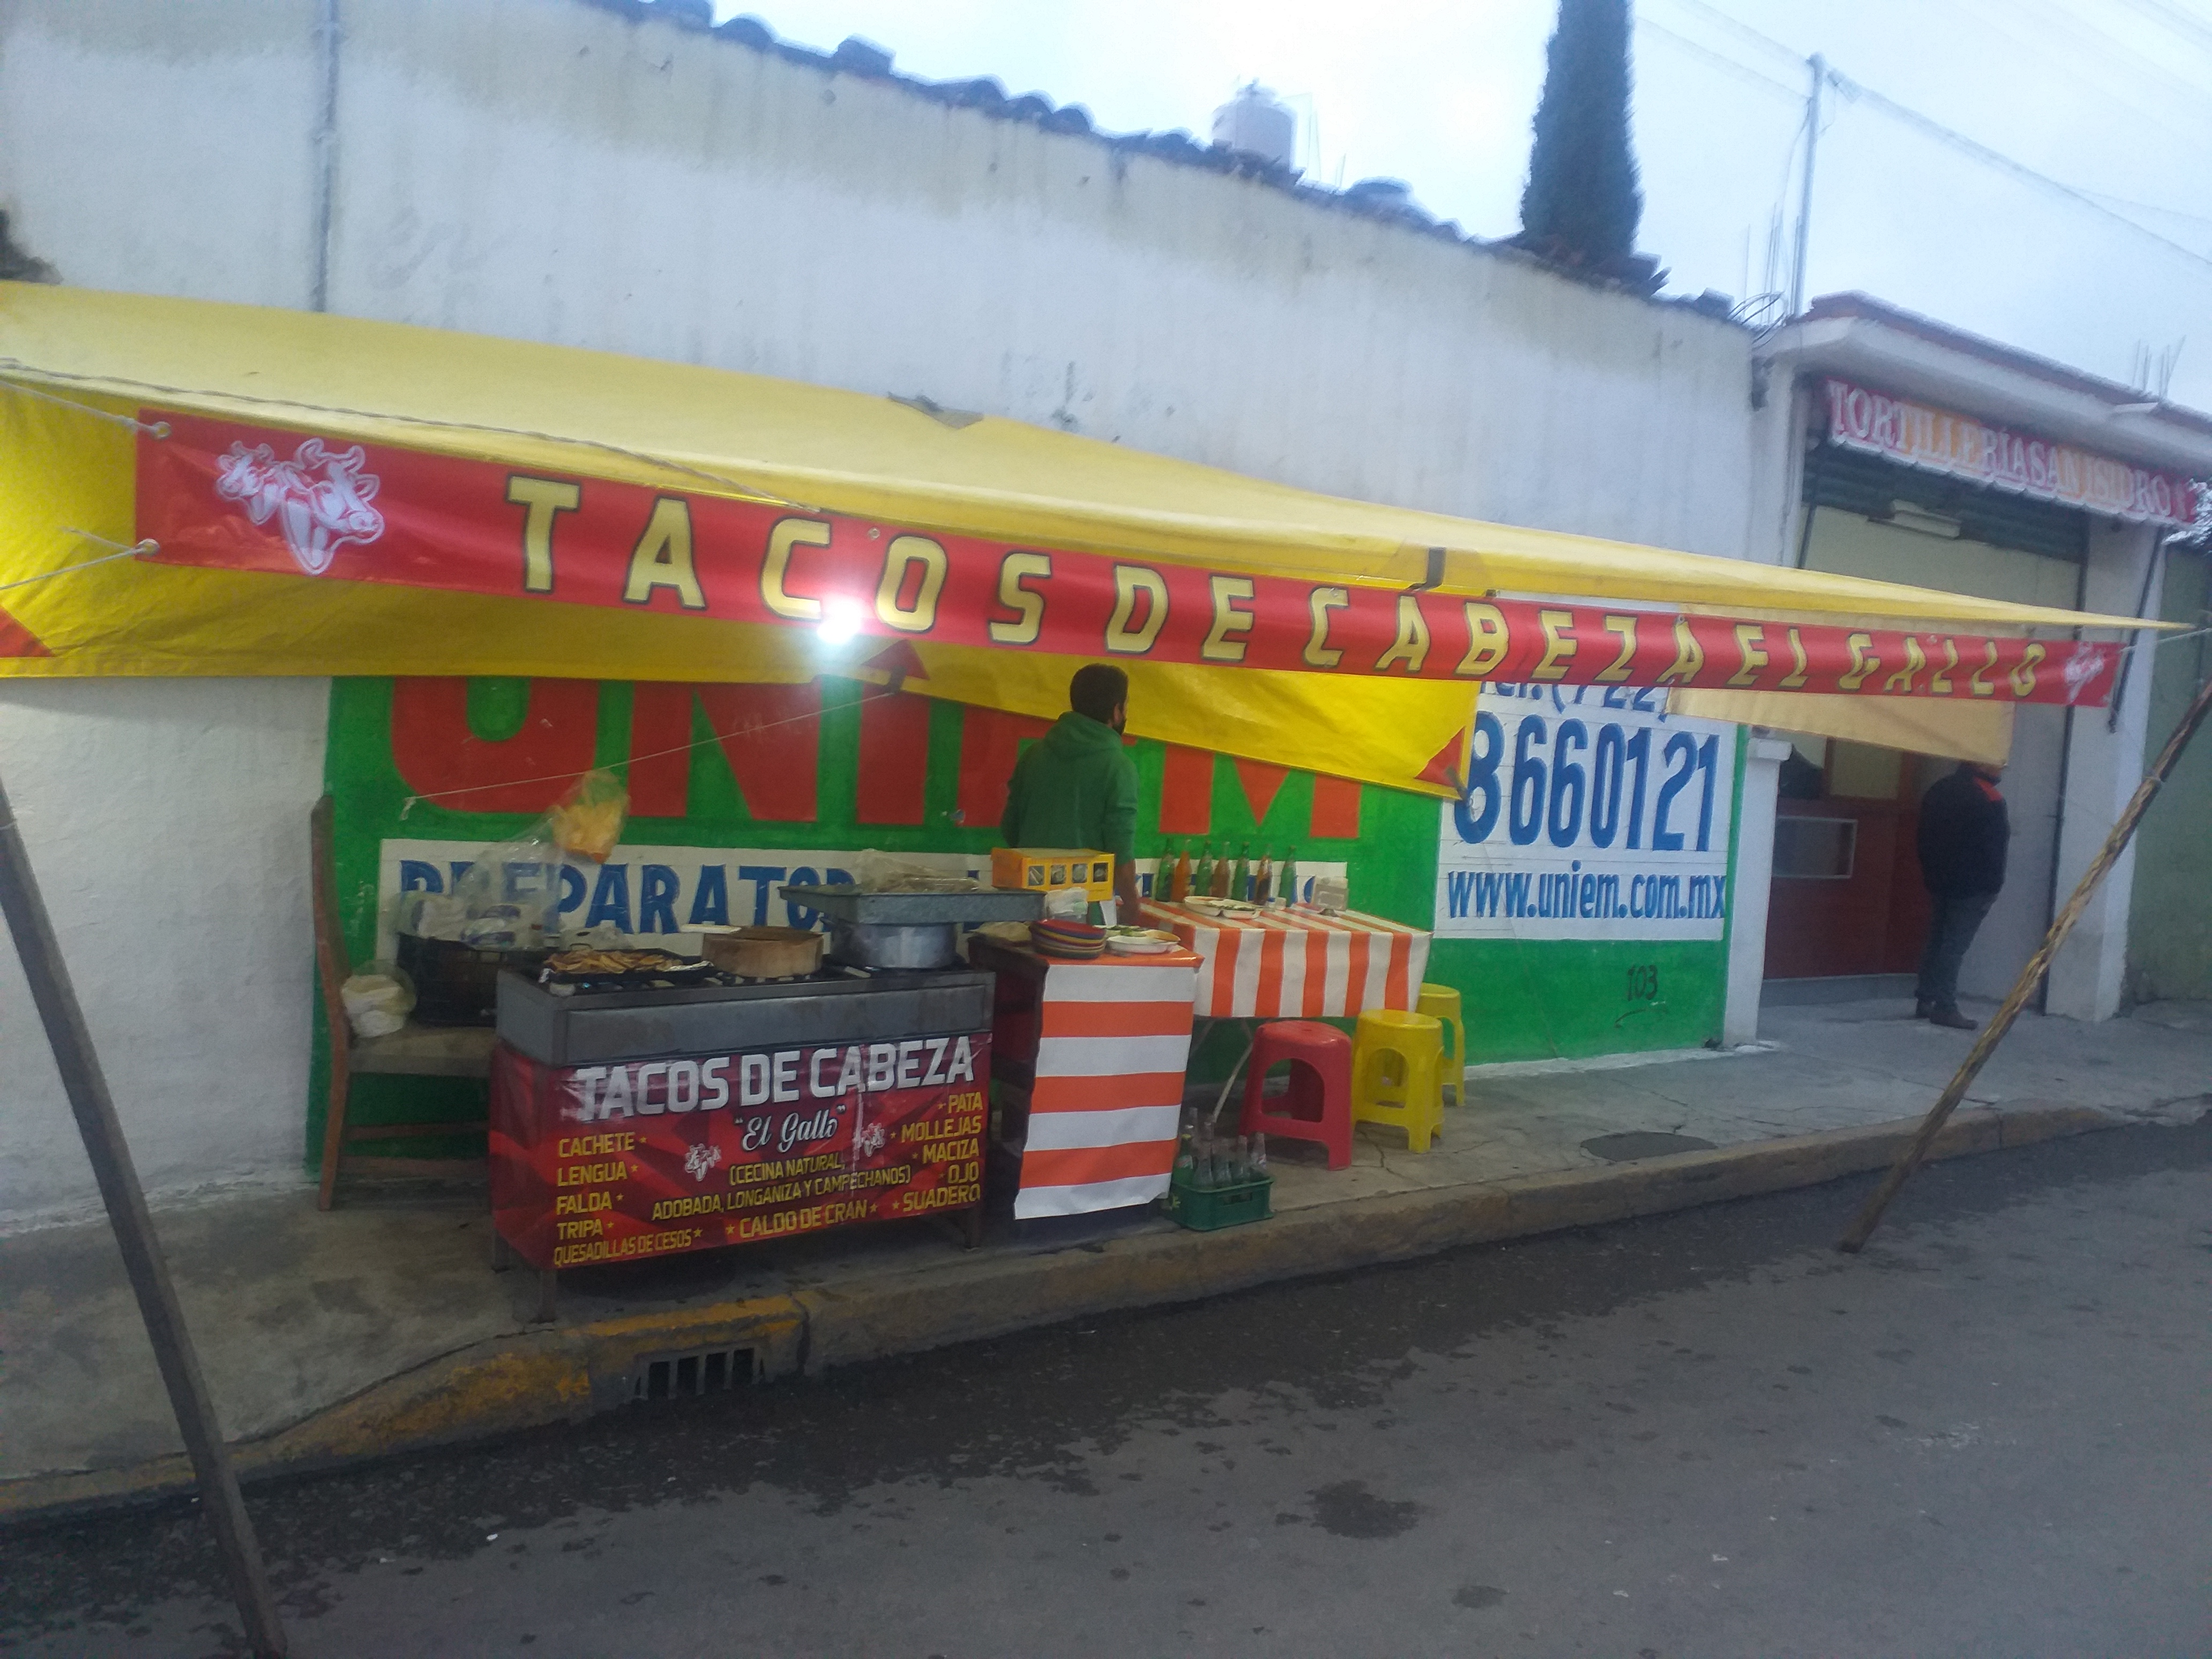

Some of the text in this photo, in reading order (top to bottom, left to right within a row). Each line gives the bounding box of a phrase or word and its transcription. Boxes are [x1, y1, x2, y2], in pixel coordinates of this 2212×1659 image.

[506, 475, 2046, 697] TACOS DE CABEZA EL GALLO
[1453, 710, 1721, 852] 8660121
[1448, 859, 1727, 919] www.uniem.com.mx
[1627, 965, 1658, 1002] 103
[573, 1036, 975, 1123] TACOS DE CABEZA
[948, 1092, 984, 1114] PATA
[901, 1115, 983, 1143] MOLLEJAS
[558, 1132, 636, 1158] CACHETE
[922, 1137, 980, 1164] MACIZA
[557, 1161, 628, 1186] LENGUA
[729, 1152, 846, 1186] (CECINA NATURAL,
[947, 1161, 980, 1184] OJO
[556, 1191, 612, 1215] FALDA
[651, 1164, 911, 1221] ADOBADA, LONGANIZA Y CAMPECHANOS)
[902, 1183, 981, 1212] SUADERO
[556, 1218, 604, 1240] TRIPA
[739, 1199, 869, 1238] CALDO DE CRAN
[553, 1237, 637, 1267] QUESADILLAS
[637, 1233, 654, 1253] DE
